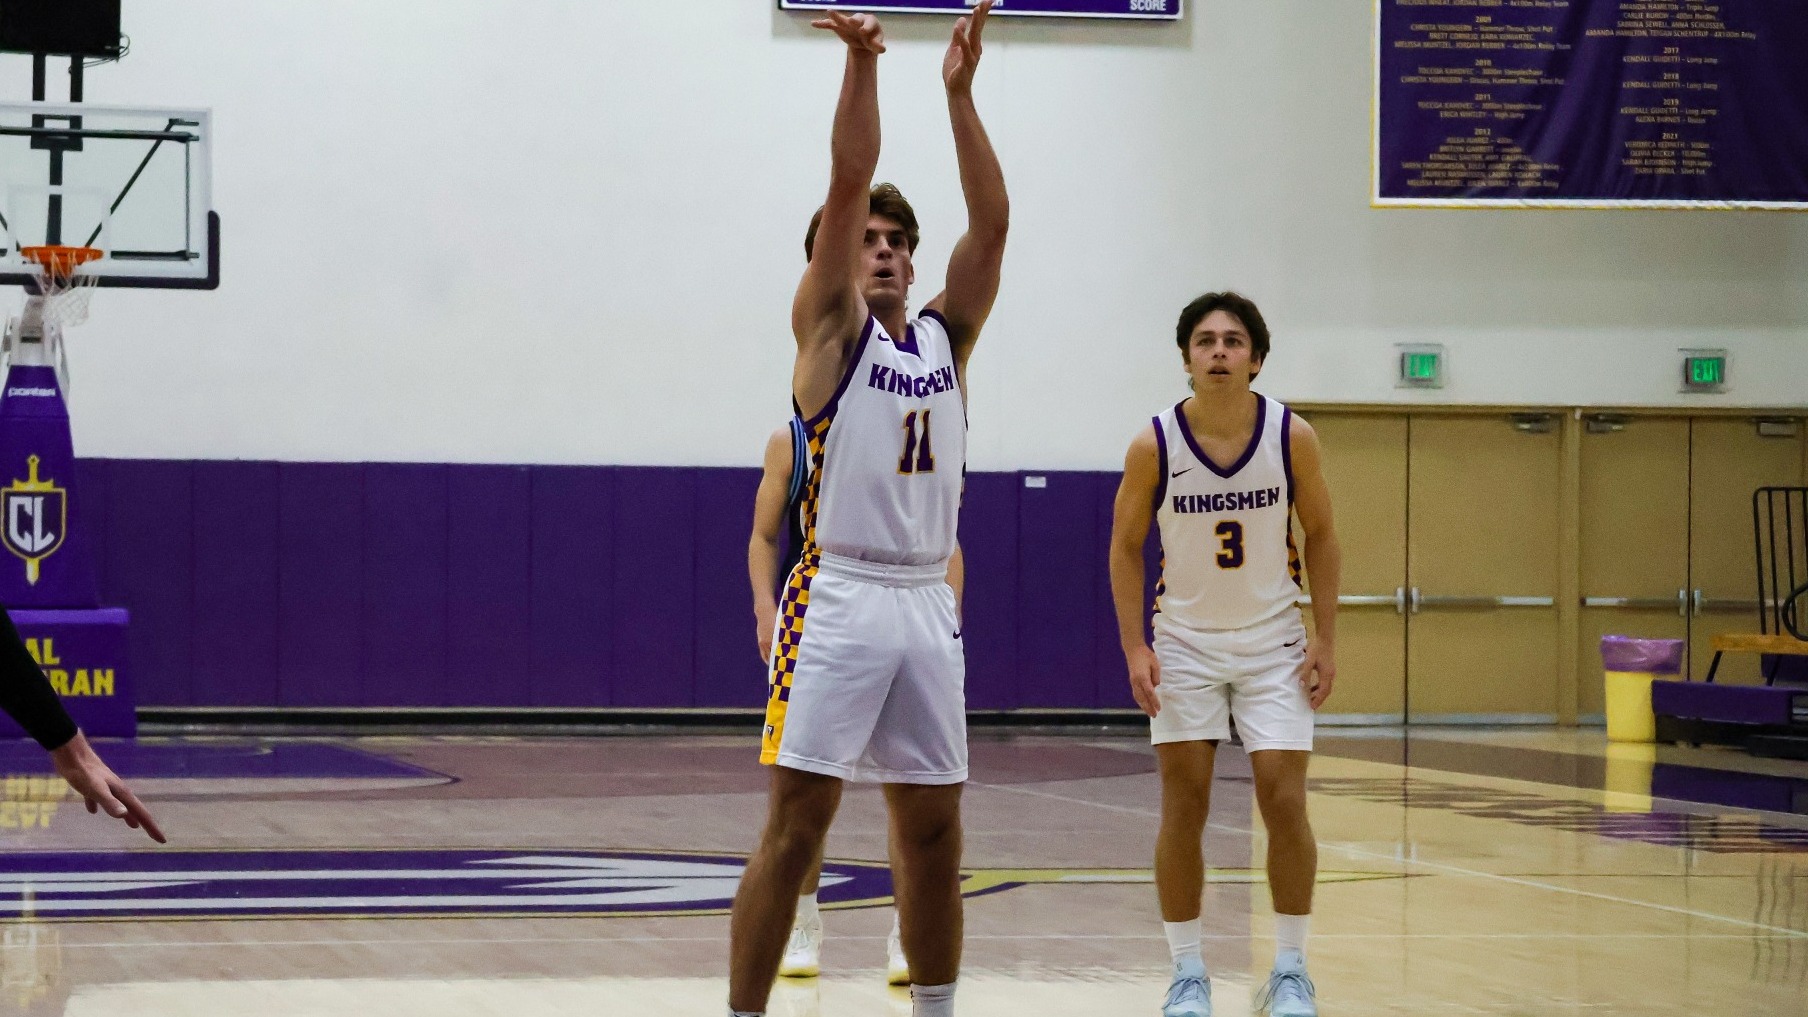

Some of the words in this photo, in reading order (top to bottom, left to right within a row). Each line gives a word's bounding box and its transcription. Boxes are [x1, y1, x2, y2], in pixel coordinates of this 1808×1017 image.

[896, 408, 936, 476] 11
[9, 496, 54, 553] CL
[1173, 487, 1280, 514] KINGSMEN
[1214, 519, 1247, 570] 3
